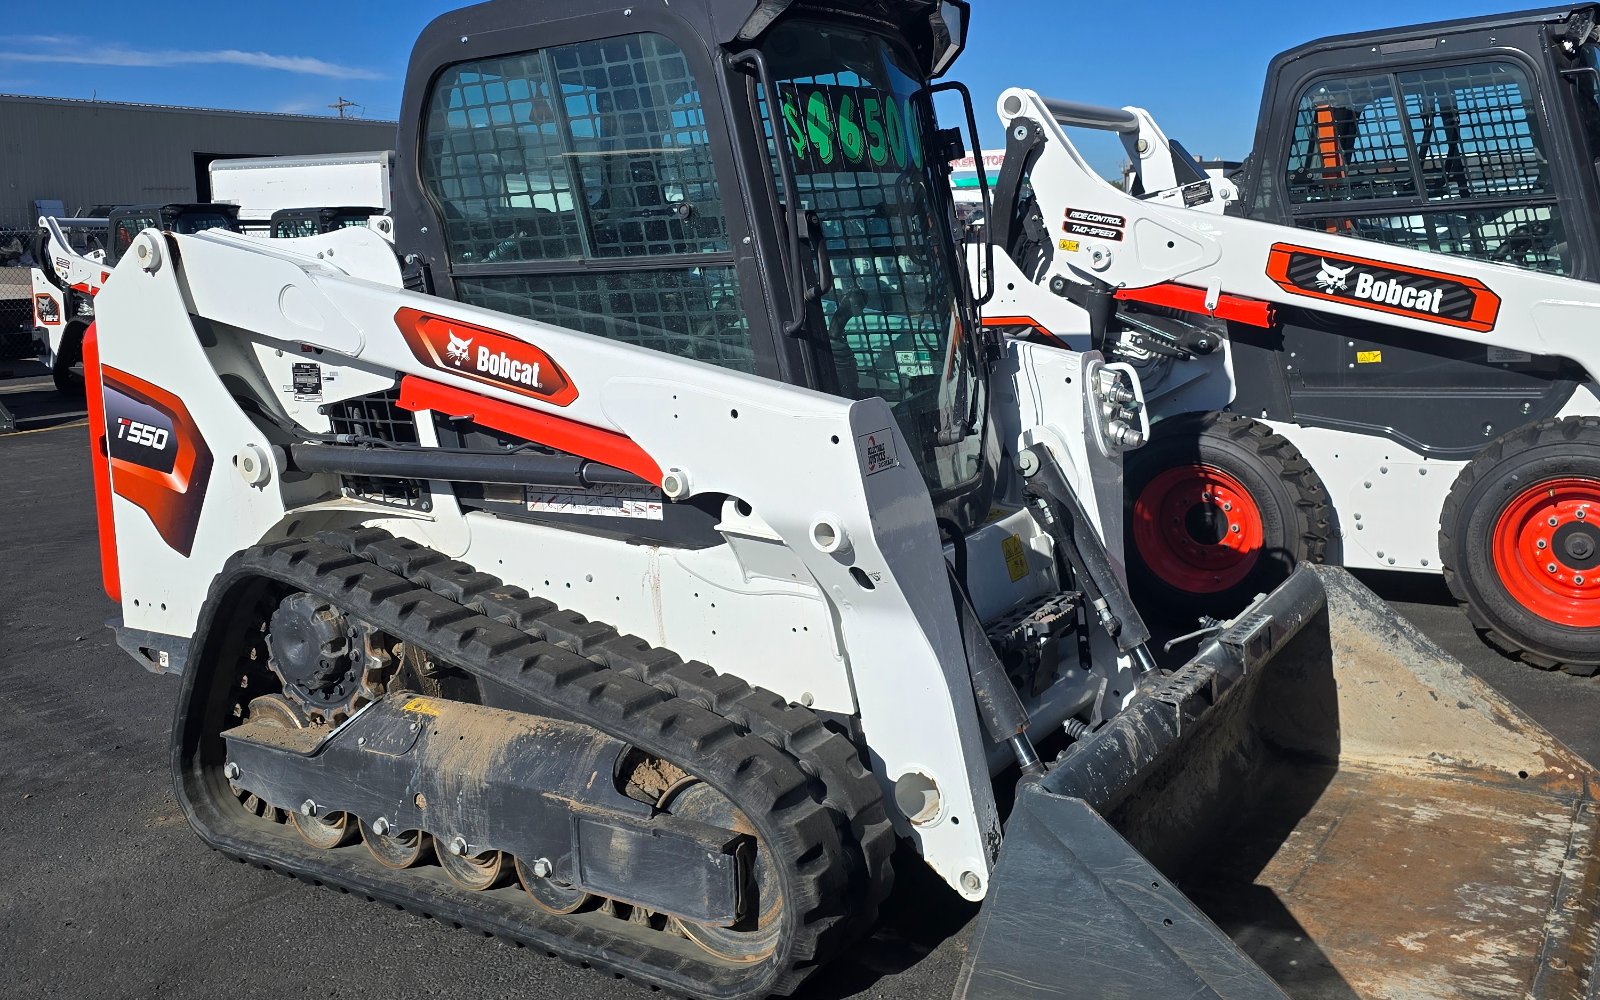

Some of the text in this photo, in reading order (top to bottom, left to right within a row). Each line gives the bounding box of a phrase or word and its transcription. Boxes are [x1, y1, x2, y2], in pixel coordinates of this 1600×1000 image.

[1069, 211, 1122, 225] RIDE CONTROL
[1071, 225, 1117, 238] TWO-SPEED
[1355, 272, 1443, 314] Bobcat
[476, 345, 540, 388] Bobcat
[117, 417, 169, 451] T550
